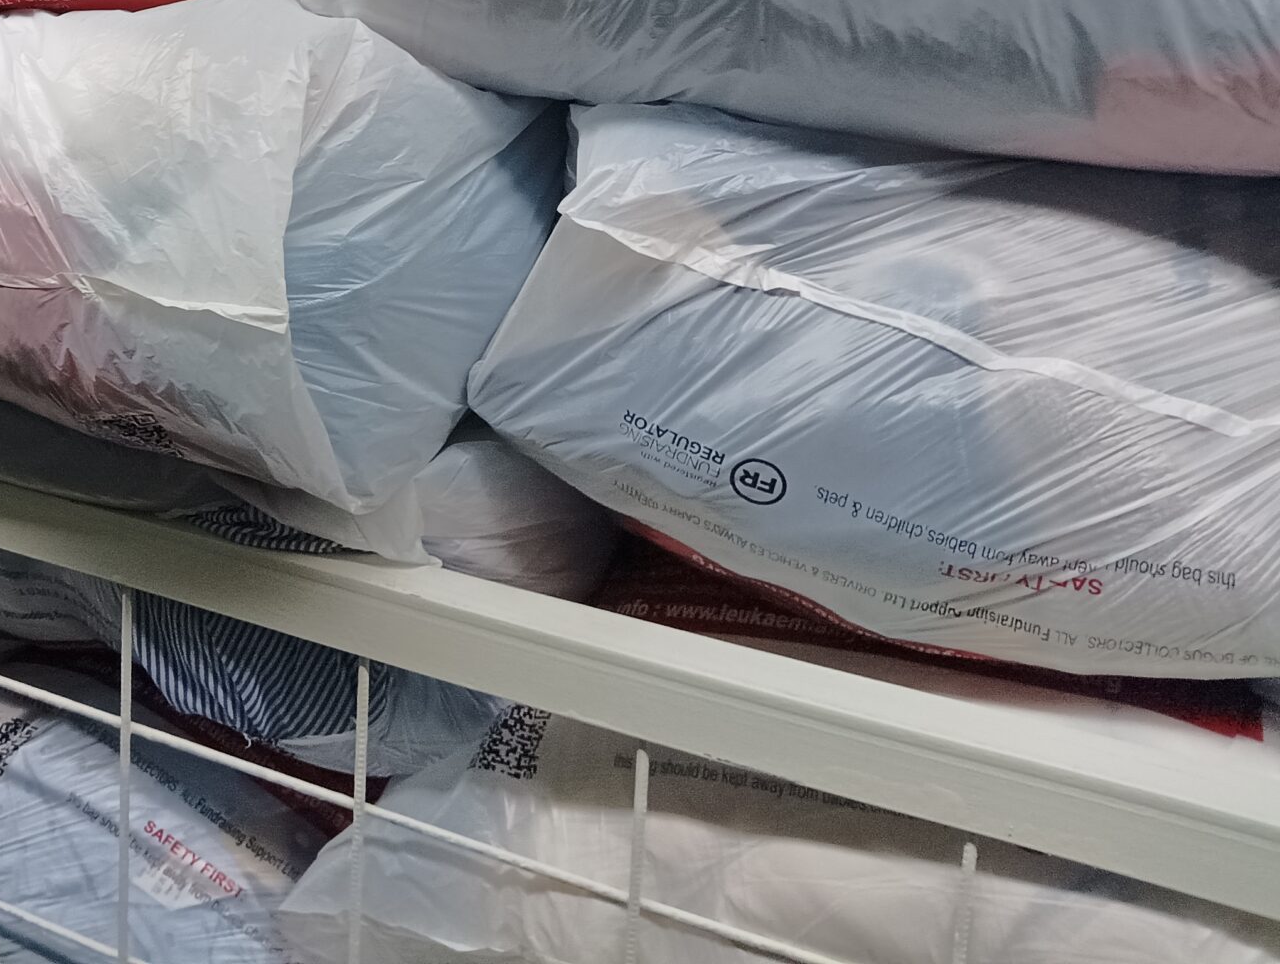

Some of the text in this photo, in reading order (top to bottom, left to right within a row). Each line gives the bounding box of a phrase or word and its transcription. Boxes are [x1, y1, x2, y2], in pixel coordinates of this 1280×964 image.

[619, 421, 721, 479] FUNDRAISING
[623, 409, 726, 466] REGULATOR
[739, 468, 778, 495] FR
[661, 502, 701, 527] CARRY
[851, 500, 863, 518] &
[866, 504, 977, 560] babies,children
[749, 543, 809, 573] VEHICLES
[811, 565, 819, 577] &
[1115, 558, 1167, 578] should
[820, 569, 876, 597] DRIVERS
[1171, 561, 1202, 585] bag
[1208, 569, 1236, 589] this
[1054, 629, 1078, 647] ALL
[659, 758, 701, 779] should
[701, 765, 719, 782] be
[750, 777, 786, 798] away
[143, 820, 204, 870] SAFETY
[194, 797, 248, 847] Fundraising
[245, 837, 284, 870] Support
